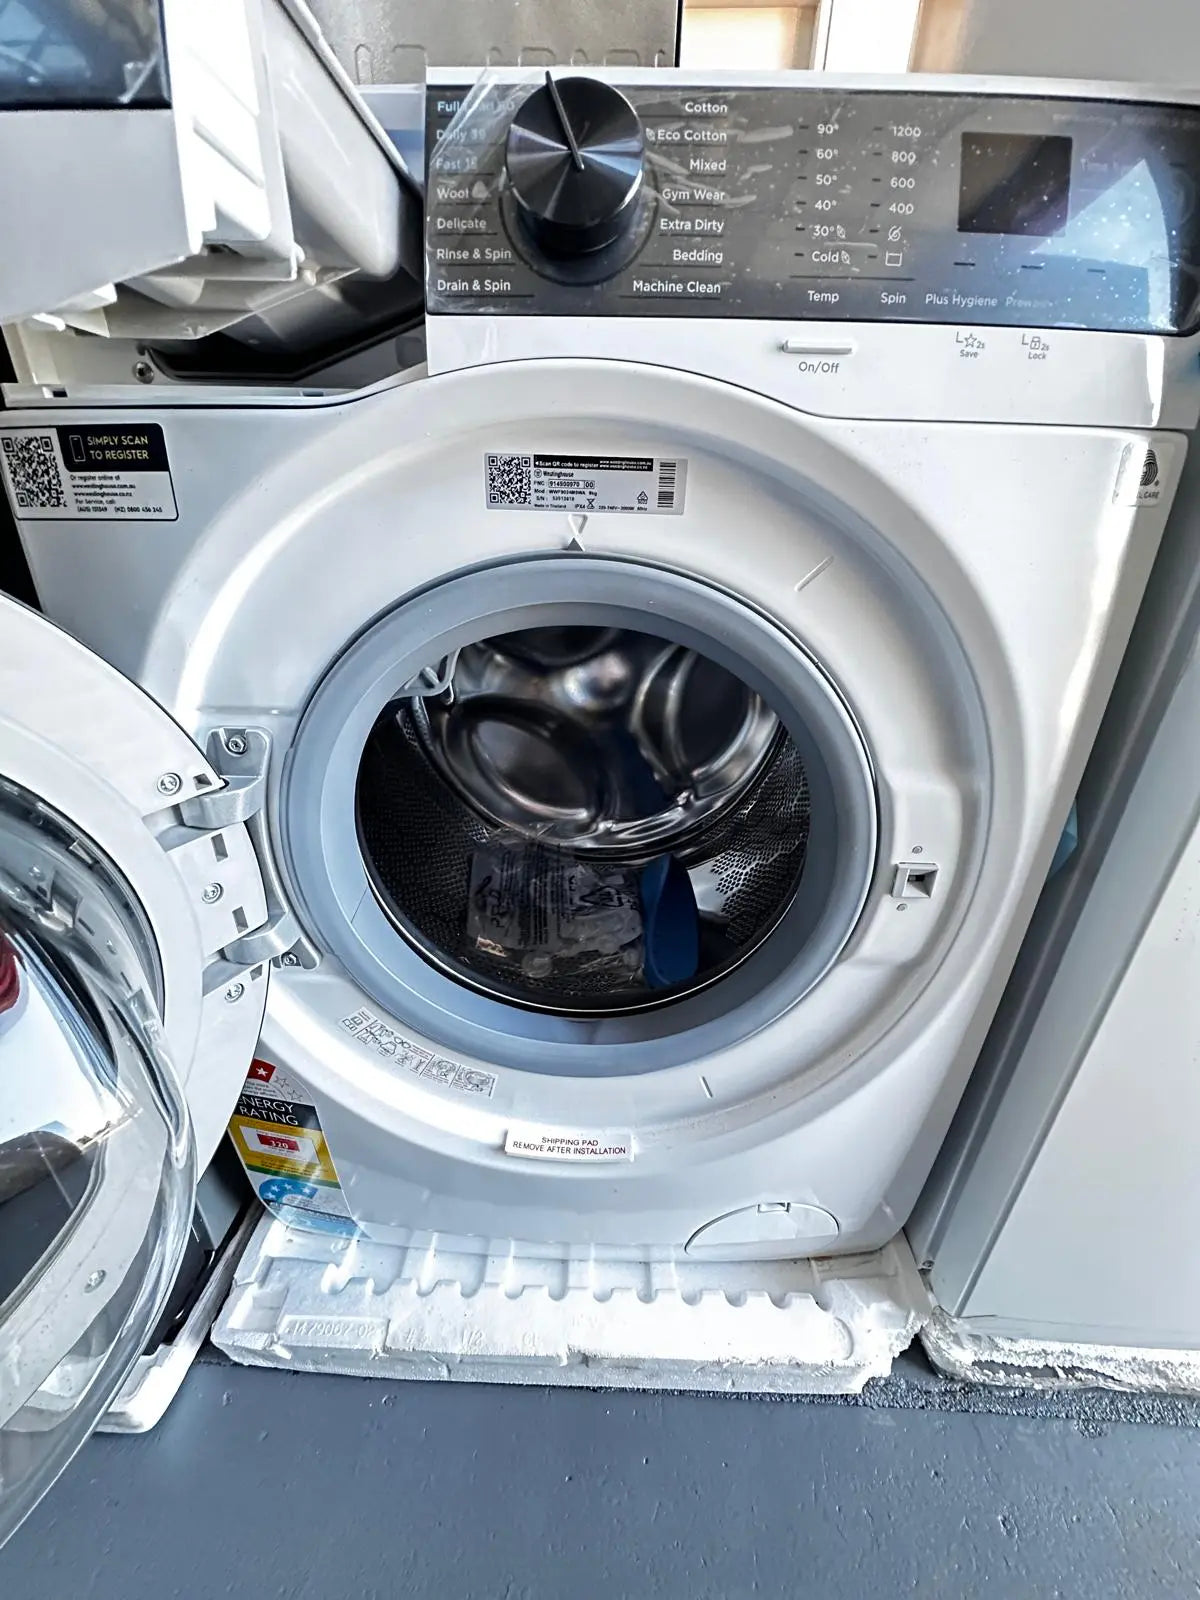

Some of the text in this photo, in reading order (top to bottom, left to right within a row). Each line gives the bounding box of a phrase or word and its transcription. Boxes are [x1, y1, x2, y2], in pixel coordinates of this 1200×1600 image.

[437, 101, 460, 112] Full
[685, 102, 728, 113] Cotton
[657, 129, 727, 141] Eco Cotton
[893, 126, 921, 137] 1200
[892, 151, 917, 163] 800
[690, 159, 727, 171] Mixed
[816, 174, 838, 185] 50°
[891, 177, 915, 189] 600
[437, 187, 469, 199] Wool
[662, 188, 725, 201] Gym Wear
[889, 203, 914, 214] 400
[437, 217, 487, 229] Delicate
[660, 218, 724, 232] Extra Dirty
[813, 225, 835, 236] 30°
[437, 247, 512, 262] Rinse & Spin
[673, 249, 723, 264] Bedding
[812, 251, 840, 262] Cold
[437, 279, 511, 292] Drain & Spin
[633, 280, 721, 293] Machine Clean
[808, 290, 839, 304] Temp
[881, 292, 906, 304] Spin
[925, 293, 998, 307] Plus Hygiene
[960, 349, 979, 358] Save
[1028, 351, 1047, 360] Lock
[798, 361, 839, 374] On/Off
[87, 435, 149, 446] SIMPLY SCAN
[90, 450, 149, 460] TO REGISTER
[239, 1106, 299, 1126] RATING
[512, 1140, 626, 1155] REMOVE AFTER INSTALLATION
[541, 1136, 599, 1147] SHIPPING PAD
